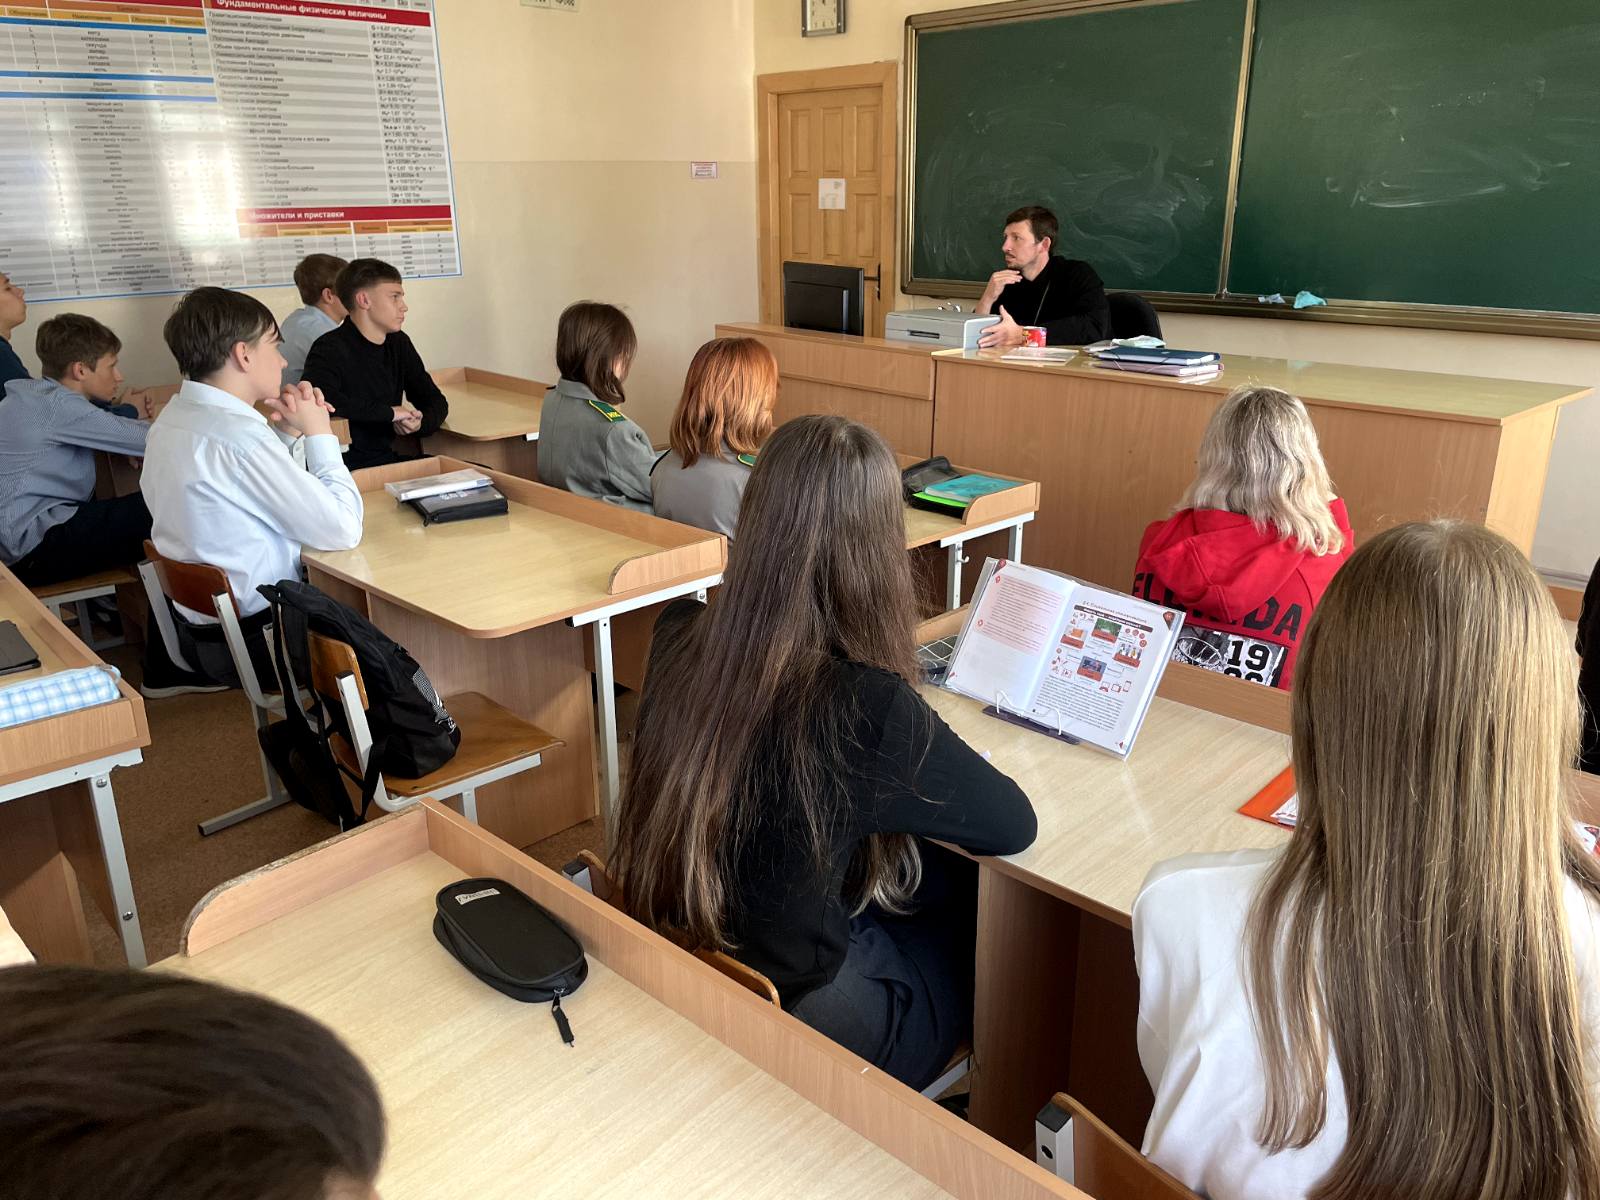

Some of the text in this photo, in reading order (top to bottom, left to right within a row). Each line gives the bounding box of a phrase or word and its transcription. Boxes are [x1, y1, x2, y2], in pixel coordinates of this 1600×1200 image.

[217, 0, 387, 20] Фундаментальные физические величины
[304, 211, 345, 221] приставки
[1227, 640, 1270, 671] 19
